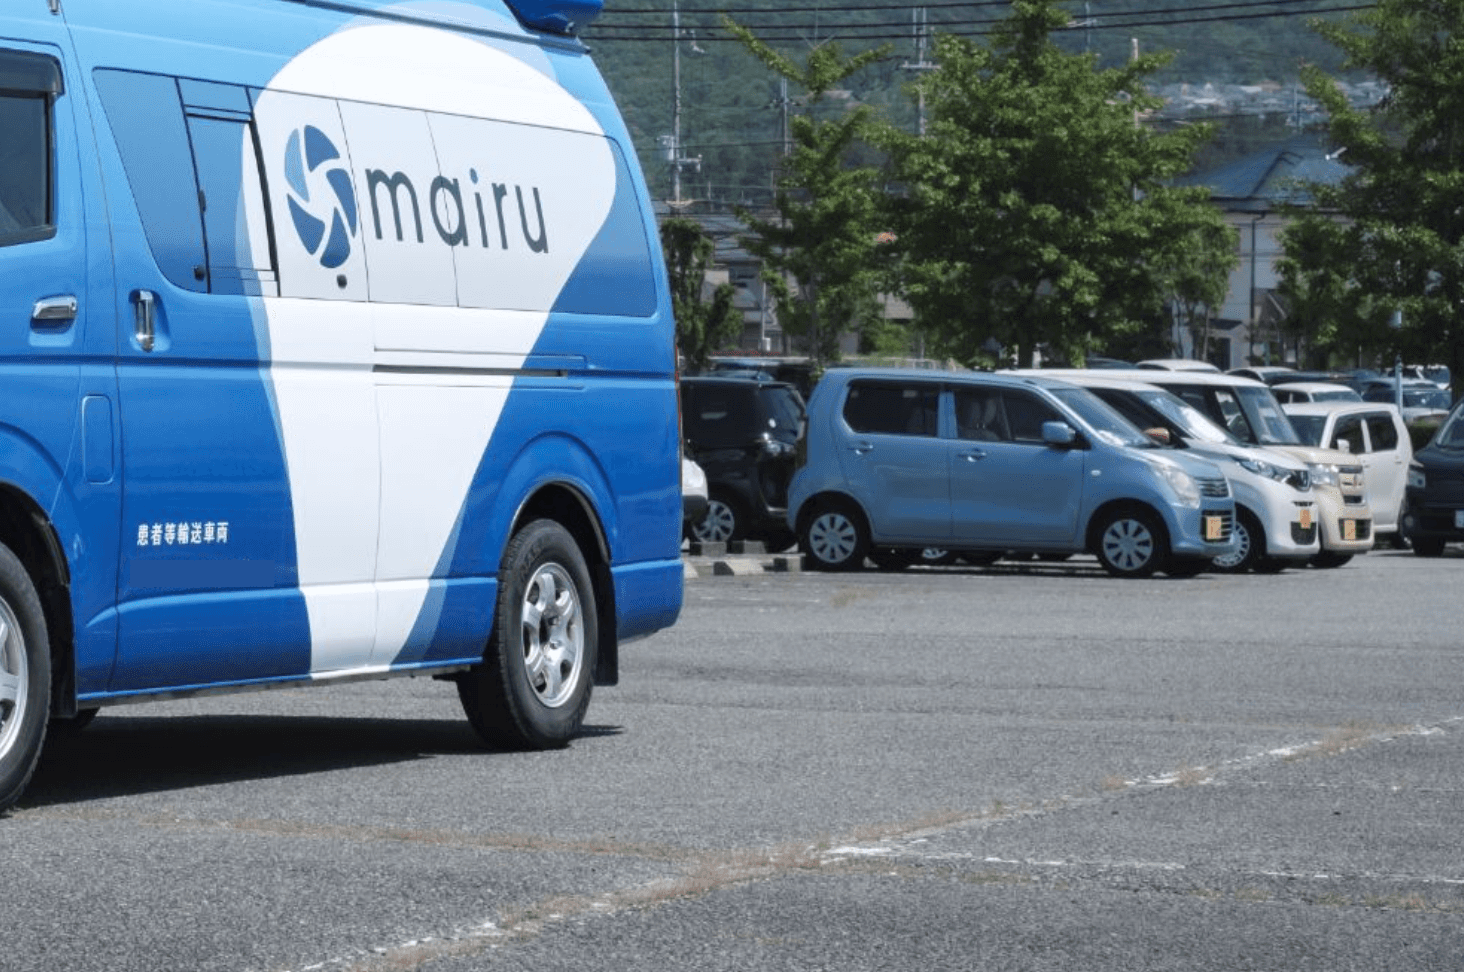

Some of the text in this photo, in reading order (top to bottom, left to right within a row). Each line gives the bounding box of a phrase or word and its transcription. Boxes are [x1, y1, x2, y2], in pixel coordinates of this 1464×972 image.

[365, 167, 549, 254] mairu
[136, 521, 229, 546] 患者等輸送車両
